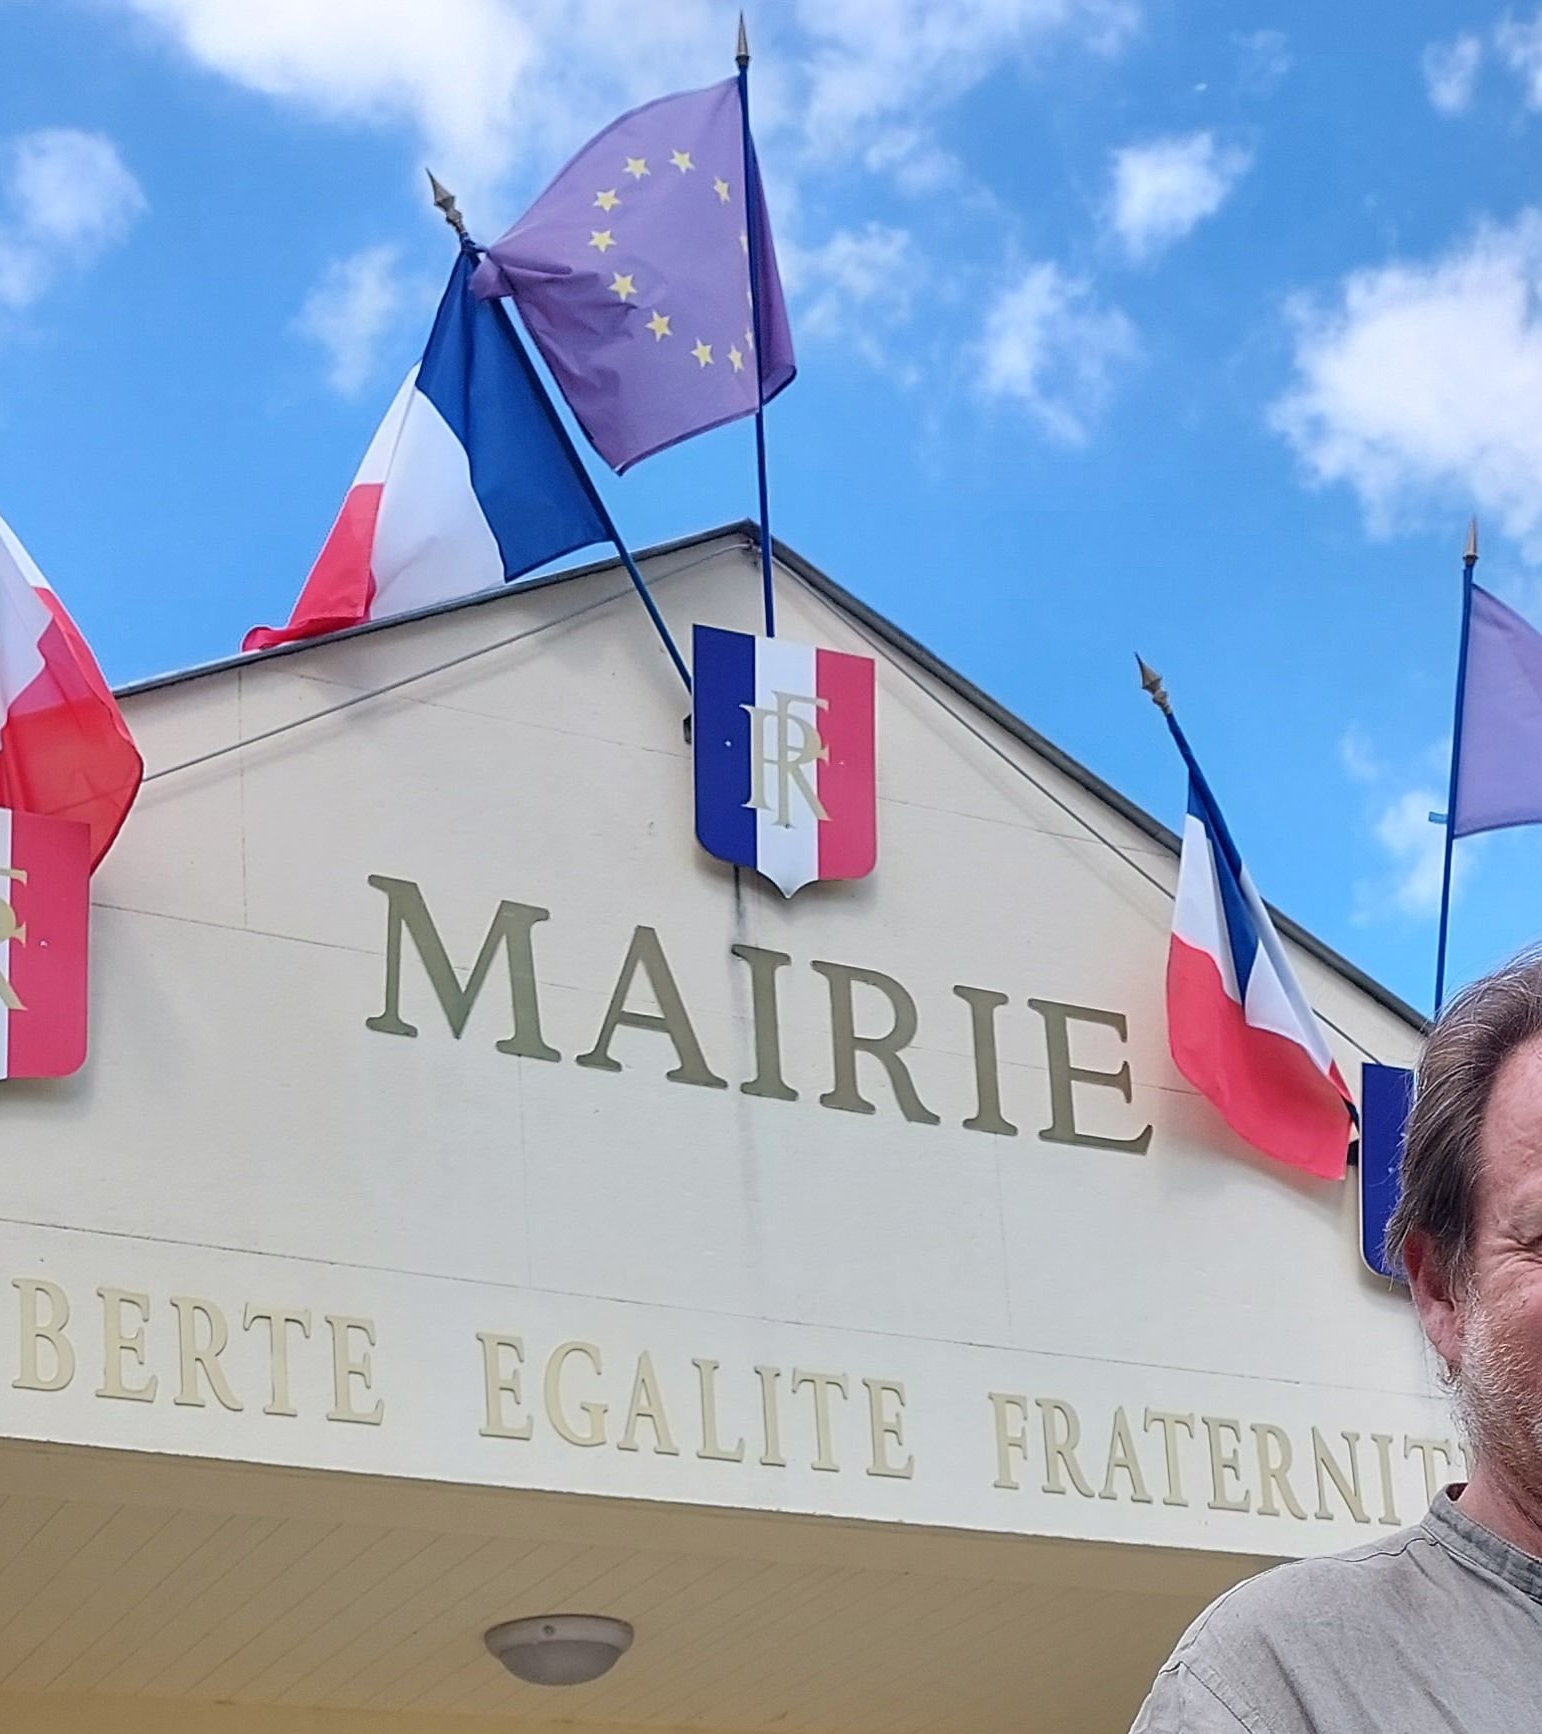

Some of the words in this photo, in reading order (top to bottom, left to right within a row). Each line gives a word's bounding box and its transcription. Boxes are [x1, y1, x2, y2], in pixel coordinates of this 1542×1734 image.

[365, 873, 1153, 1156] MAIRIE
[475, 1330, 915, 1480] EGALITE
[987, 1391, 1474, 1527] FRATERNIT
